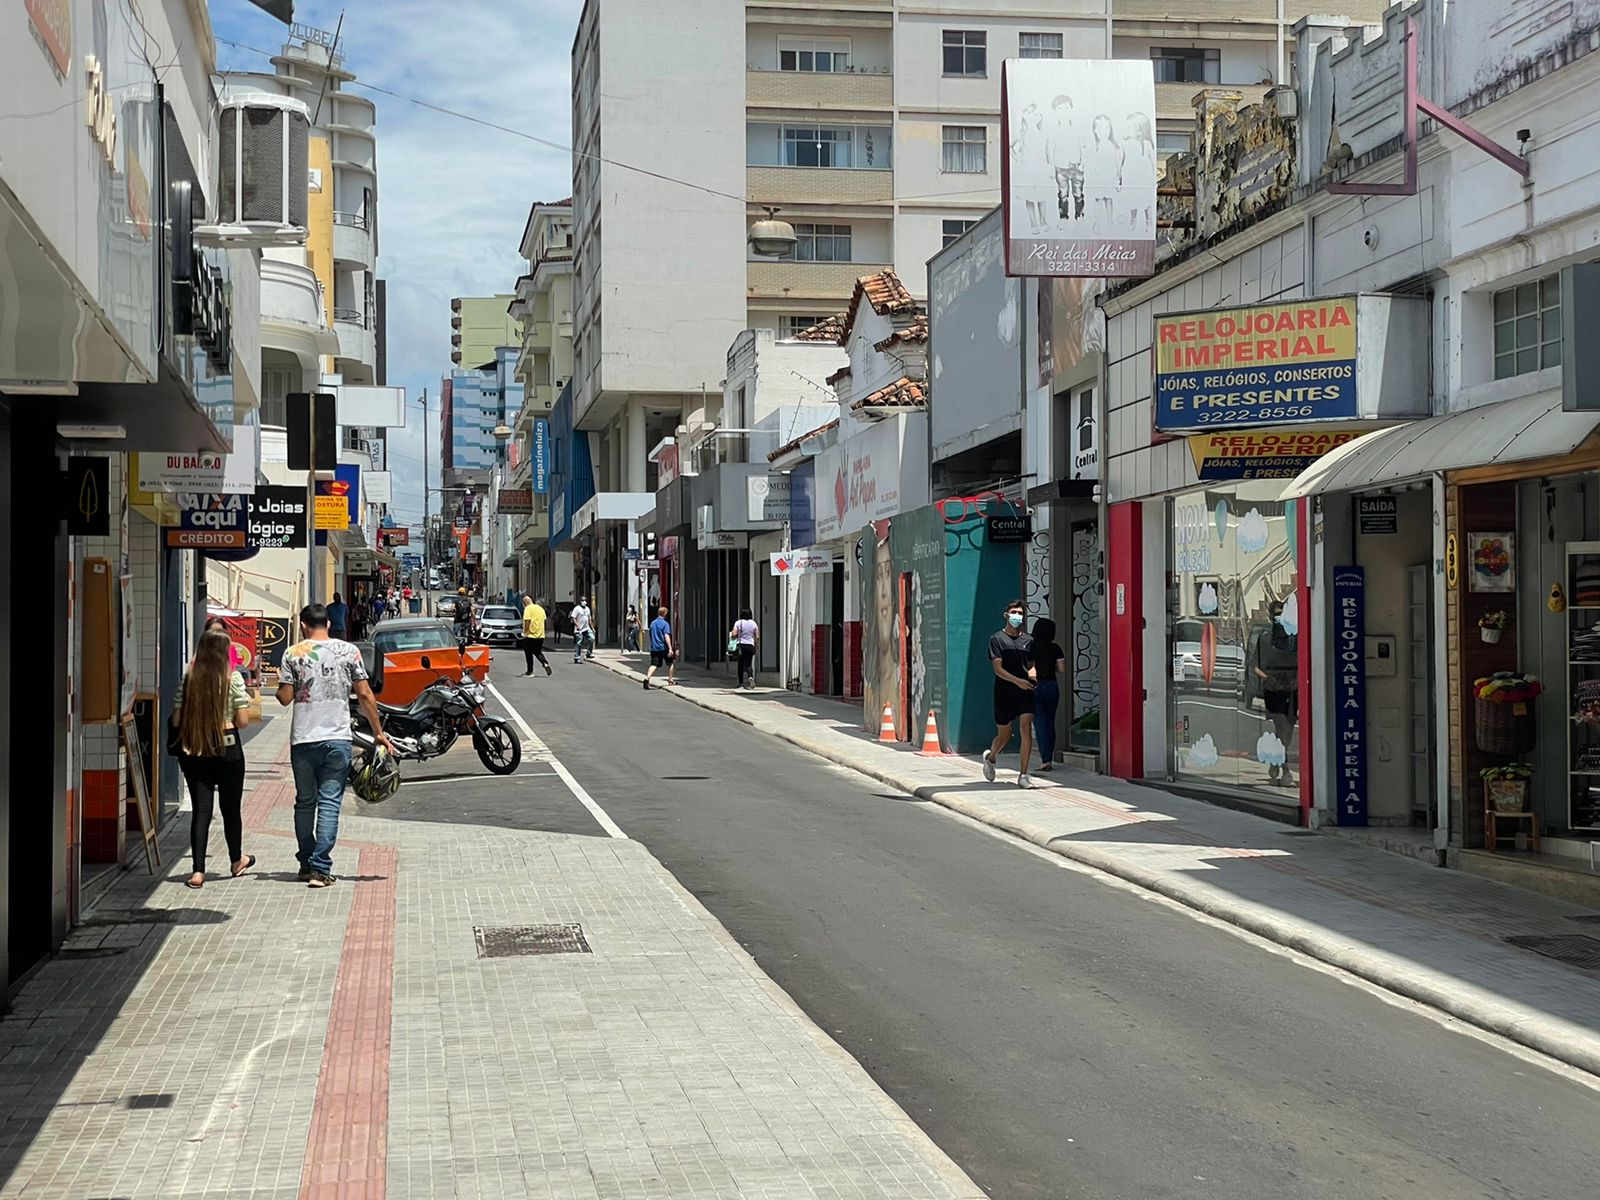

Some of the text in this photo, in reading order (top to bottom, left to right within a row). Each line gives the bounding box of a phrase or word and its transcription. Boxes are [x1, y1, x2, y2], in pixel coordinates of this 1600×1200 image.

[1027, 243, 1137, 261] Rei das Meias
[1048, 261, 1115, 272] 3221-3314
[1159, 306, 1350, 345] RELOJOARIA
[1173, 334, 1336, 368] IMPERIAL
[1159, 365, 1352, 392] JÓIAS, RELÓGIOS, CONSERTOS
[1170, 385, 1340, 411] E PRESENTES
[1197, 405, 1313, 423] 3222-8556
[1210, 434, 1360, 447] RELOJOARI
[167, 456, 181, 469] DU
[537, 422, 545, 490] magazineluiza
[1075, 450, 1098, 469] Central
[1204, 456, 1242, 468] JÓIAS,
[1243, 469, 1251, 479] E
[259, 498, 304, 514] Joias
[1361, 499, 1395, 512] SAÍDA
[191, 508, 237, 529] aqui
[991, 519, 1026, 529] Central
[1177, 503, 1210, 546] NOVA
[248, 519, 295, 538] lógios
[179, 533, 234, 544] CRÉDITO
[1448, 539, 1456, 581] 390
[264, 625, 277, 639] K
[1341, 597, 1361, 815] RELOJOARIA IMPERIAL
